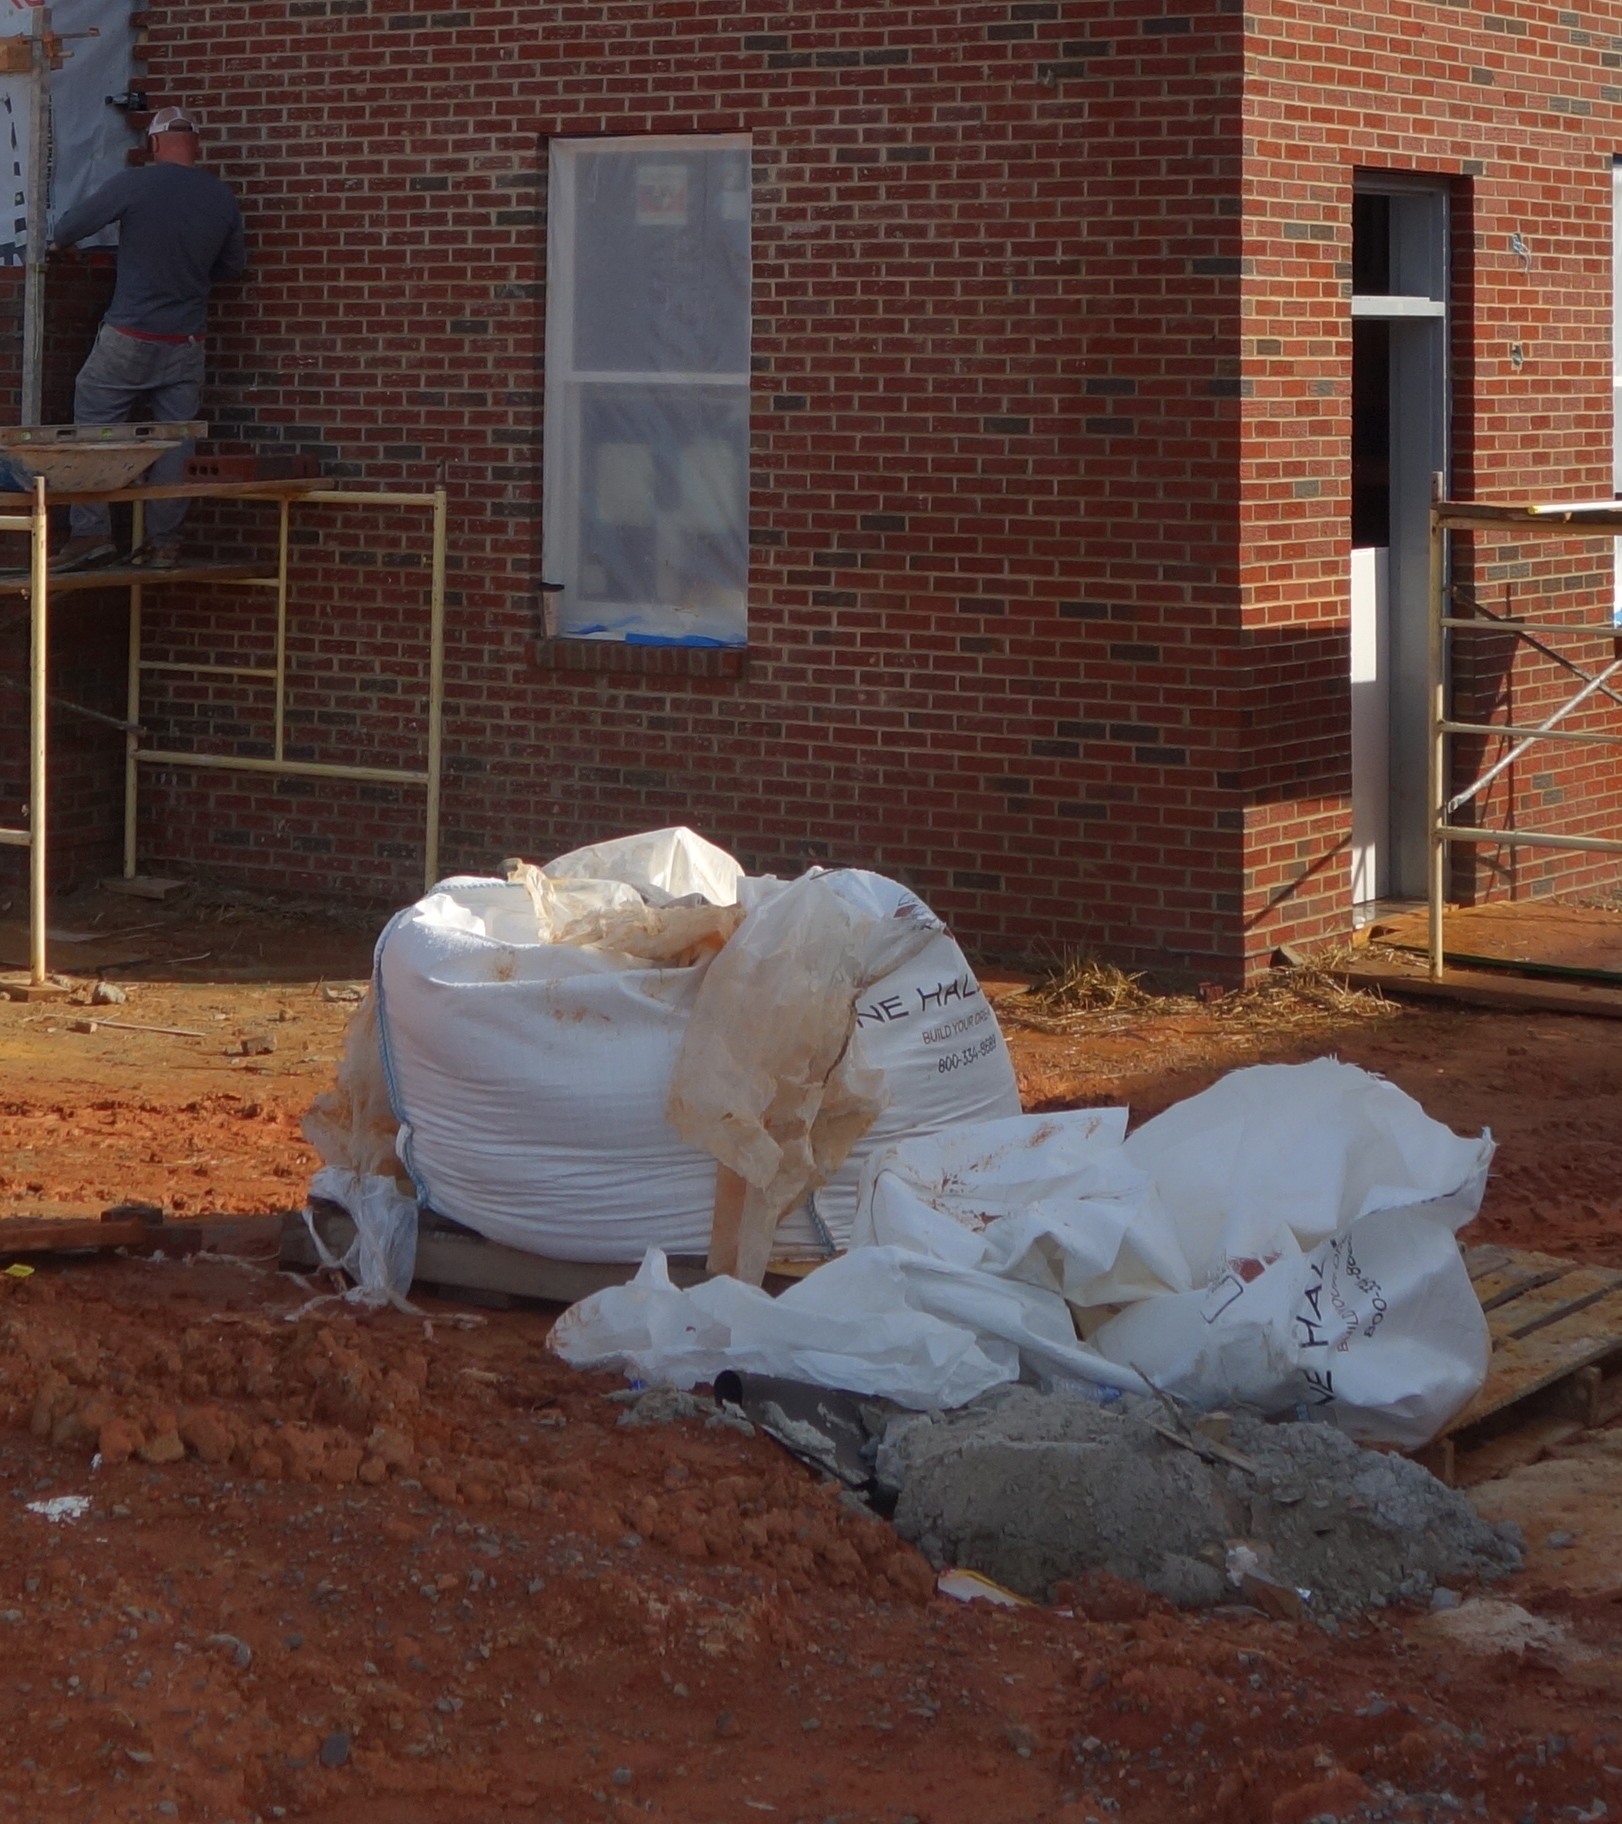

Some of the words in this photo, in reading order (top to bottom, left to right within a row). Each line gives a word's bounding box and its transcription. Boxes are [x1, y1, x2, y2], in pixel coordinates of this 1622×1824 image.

[856, 995, 909, 1028] NE
[916, 973, 979, 1012] HAL
[922, 1024, 952, 1044] BUILD
[952, 1014, 975, 1035] YOUR
[1295, 1256, 1329, 1348] HAL
